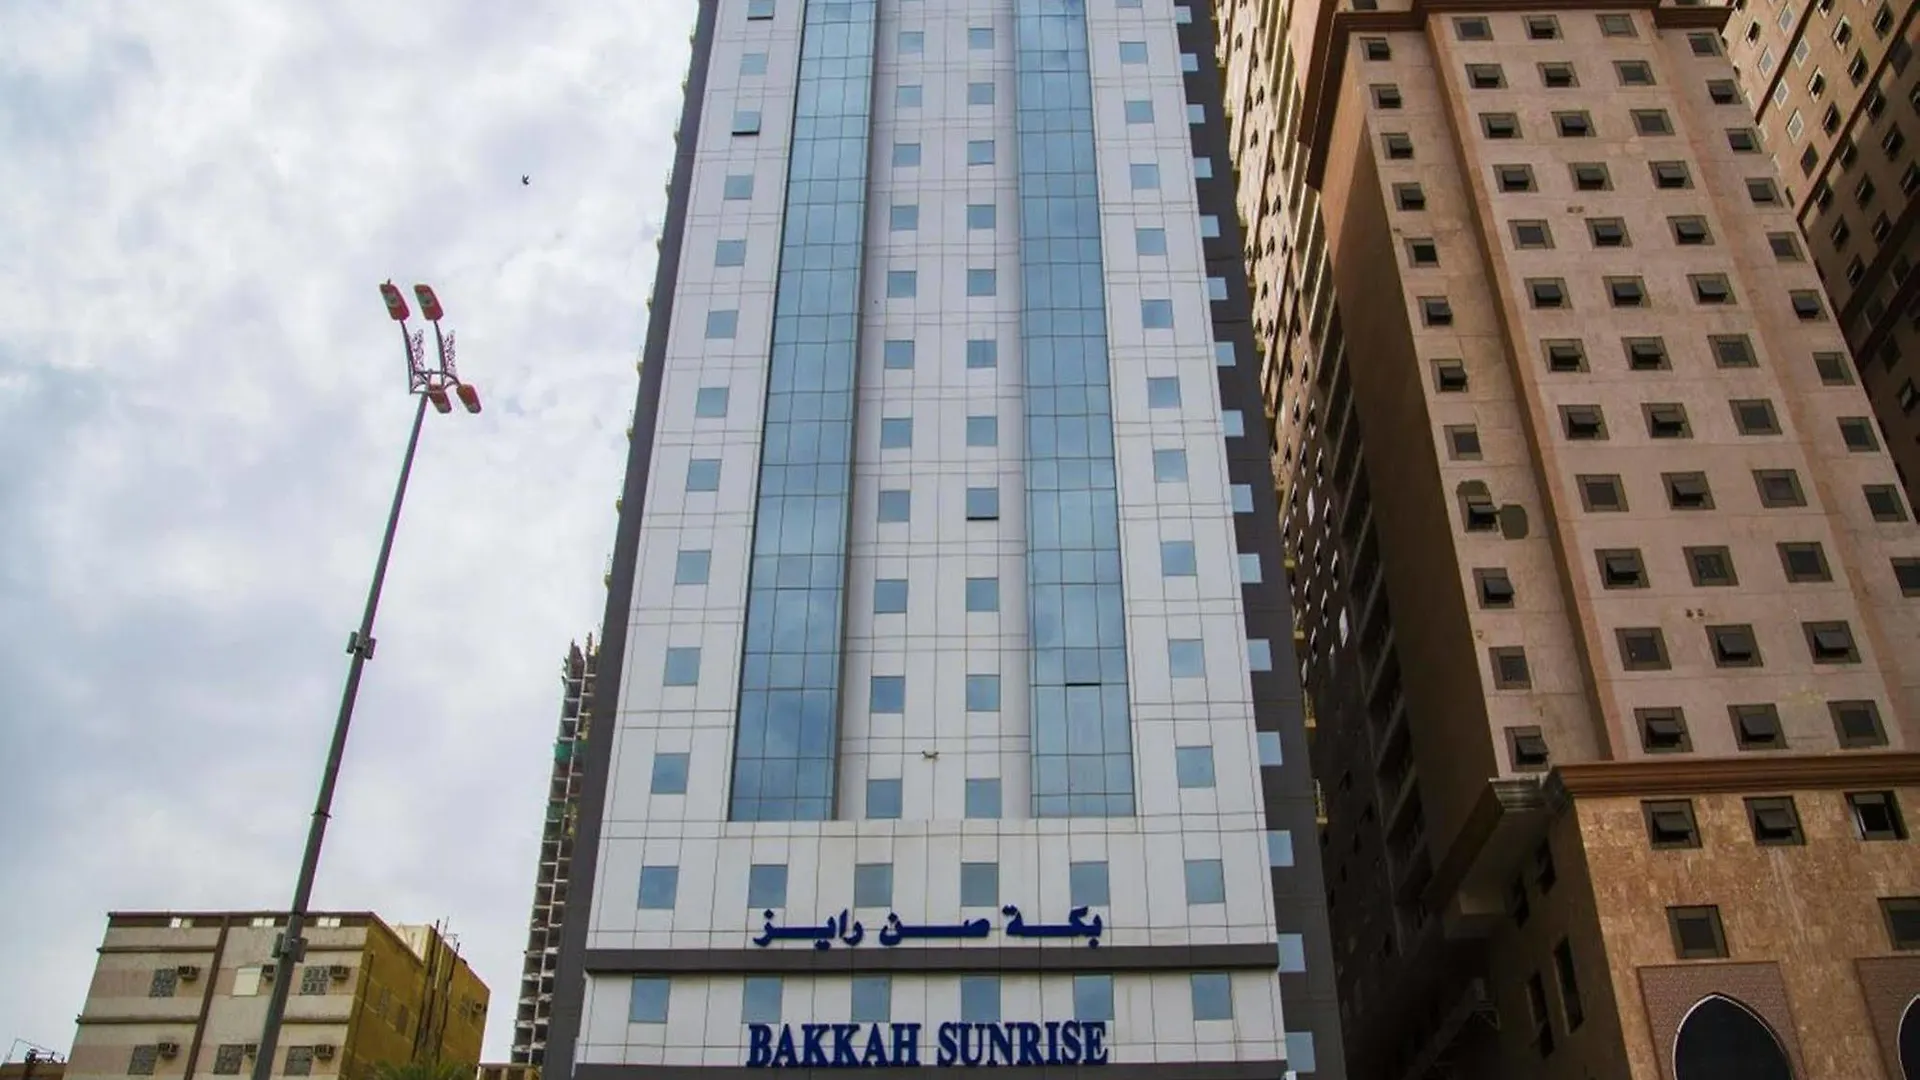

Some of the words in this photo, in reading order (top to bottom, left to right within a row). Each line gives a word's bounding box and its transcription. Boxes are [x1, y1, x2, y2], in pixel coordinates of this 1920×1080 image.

[753, 909, 864, 950] رايز
[879, 911, 991, 946] صن
[1002, 904, 1103, 948] بكة
[746, 1022, 921, 1068] BAKKAH
[936, 1020, 1109, 1067] SUNRISE
